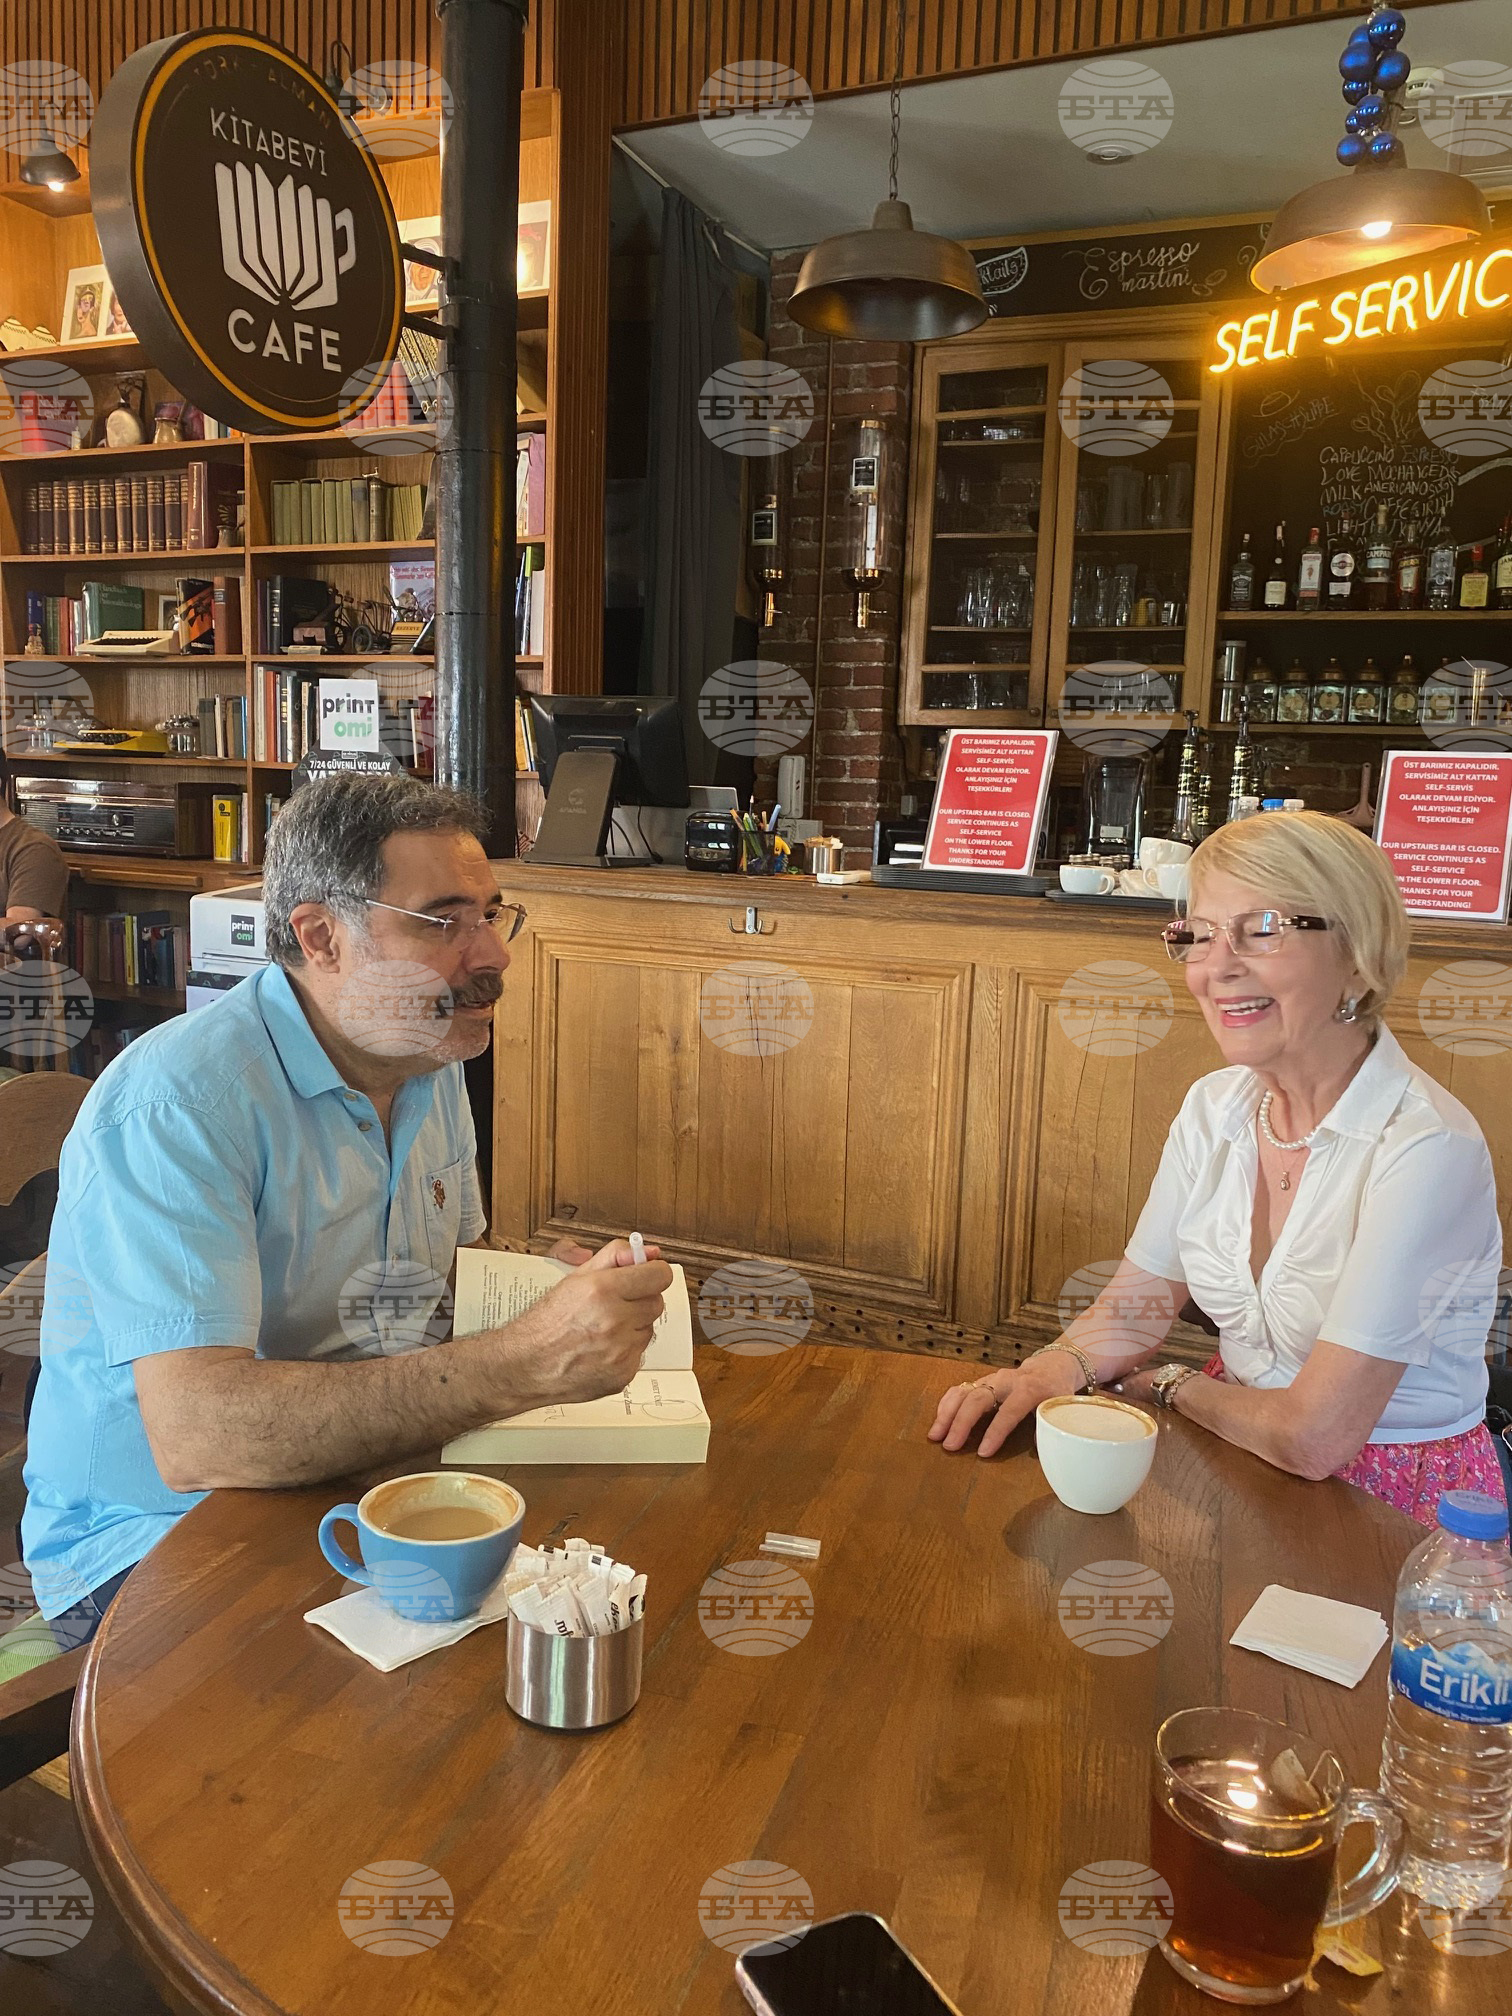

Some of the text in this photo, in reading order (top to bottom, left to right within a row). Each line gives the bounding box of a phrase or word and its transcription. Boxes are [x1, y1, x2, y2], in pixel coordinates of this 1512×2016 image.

[210, 106, 327, 177] KİTABEVİ
[1209, 249, 1512, 373] SELF SERVIC
[228, 308, 342, 372] CAFE
[334, 717, 372, 737] omi
[327, 759, 356, 769] GÜVENLİ
[368, 762, 391, 770] KOLAY
[1405, 772, 1448, 780] SERVİSİMİZ
[1425, 783, 1473, 791] SELF-SERVİS
[1463, 794, 1496, 802] EDİYOR.
[1412, 805, 1480, 814] ANLAYIŞINIZ İÇİN
[1417, 815, 1474, 824] TEŞEKKÜRLER!
[1401, 842, 1439, 850] UPSTAIRS
[1467, 845, 1501, 853] CLOSED.
[1394, 853, 1425, 861] SERVICE
[1427, 855, 1474, 863] CONTINUES
[1411, 865, 1465, 874] SELF-SERVICE
[1423, 877, 1451, 885] LOWER
[1453, 879, 1482, 887] FLOOR.
[1433, 888, 1449, 896] FOR
[1450, 889, 1473, 897] YOUR
[1404, 898, 1471, 909] NDERSTANDING!
